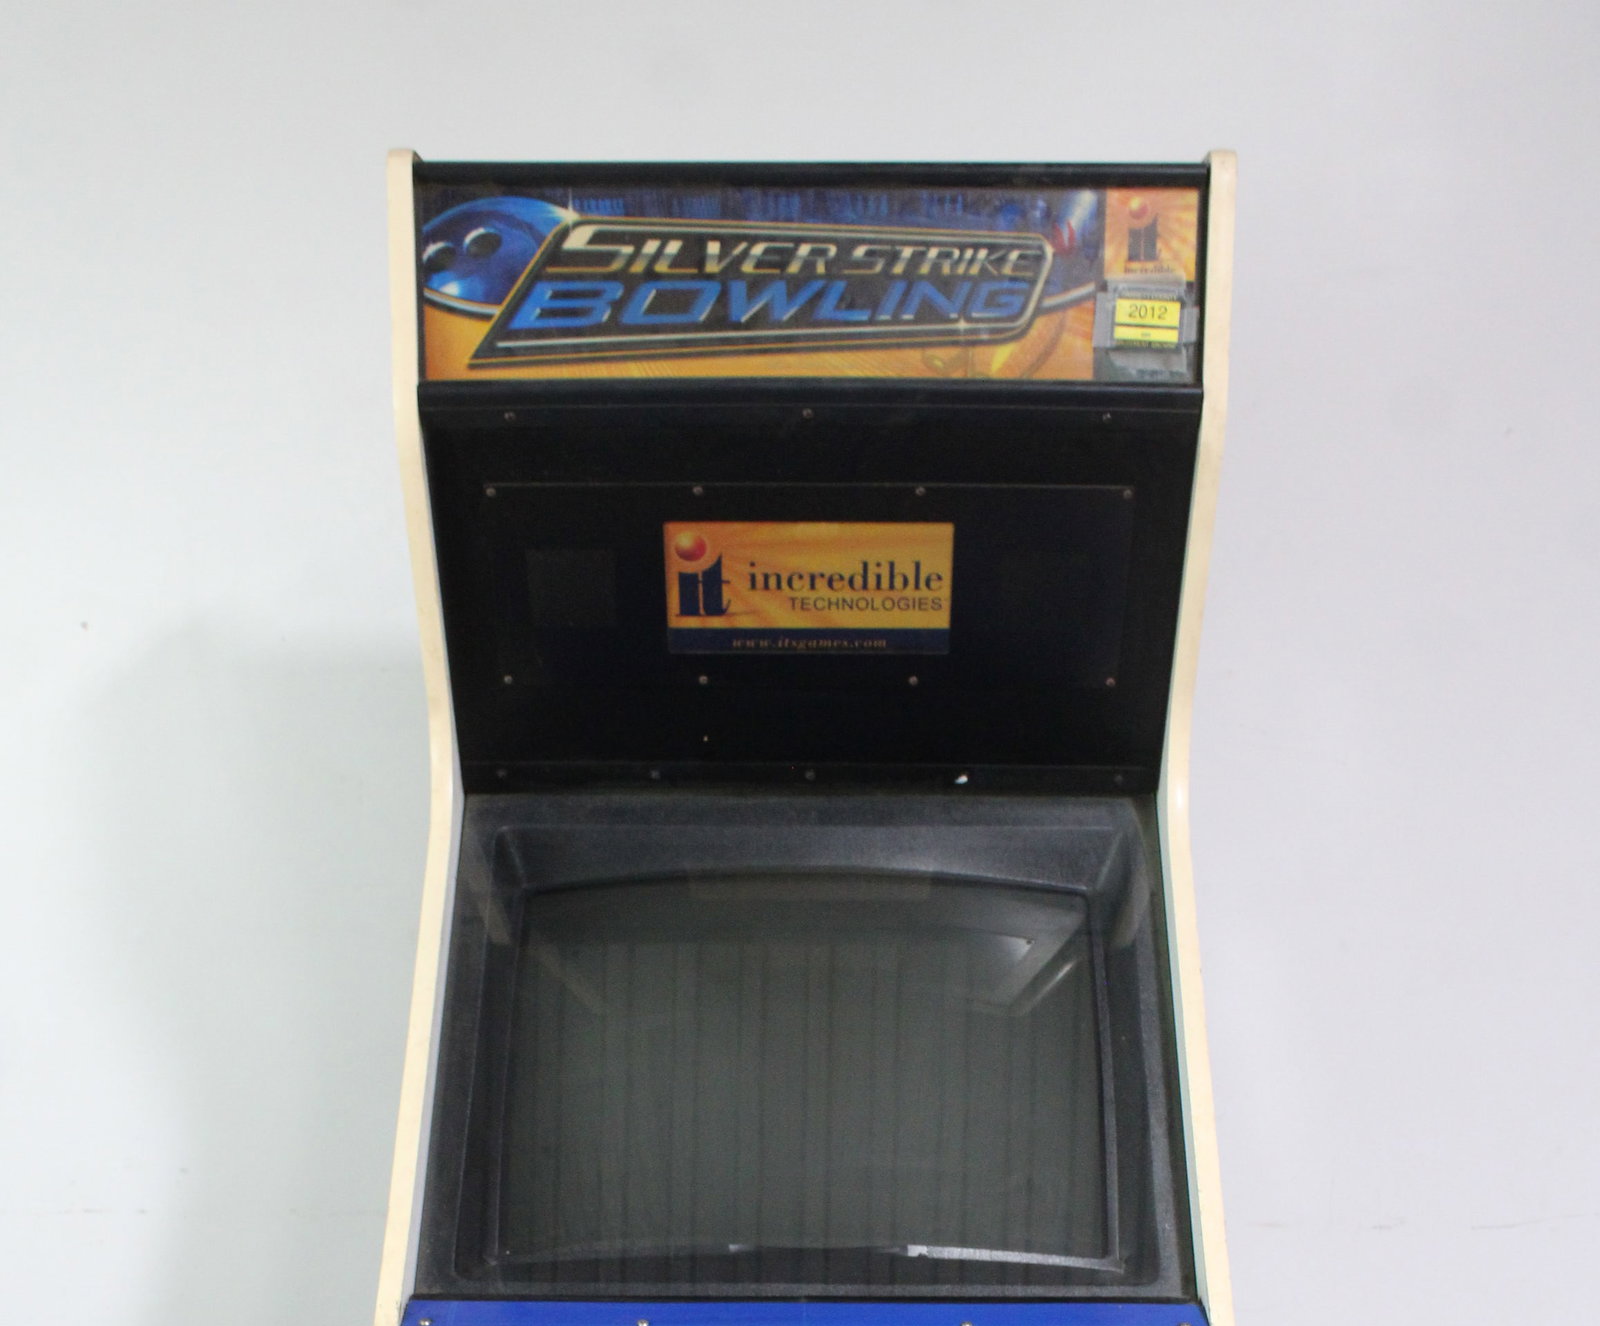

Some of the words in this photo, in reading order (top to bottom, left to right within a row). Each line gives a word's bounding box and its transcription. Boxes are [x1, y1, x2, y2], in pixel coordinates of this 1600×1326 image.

[545, 224, 836, 274] SILVER
[843, 244, 1042, 276] STRIKE
[508, 280, 1031, 330] BOWLING
[1128, 304, 1168, 321] 2012
[747, 561, 943, 592] incredible
[790, 597, 943, 612] TECHNOLOGIES
